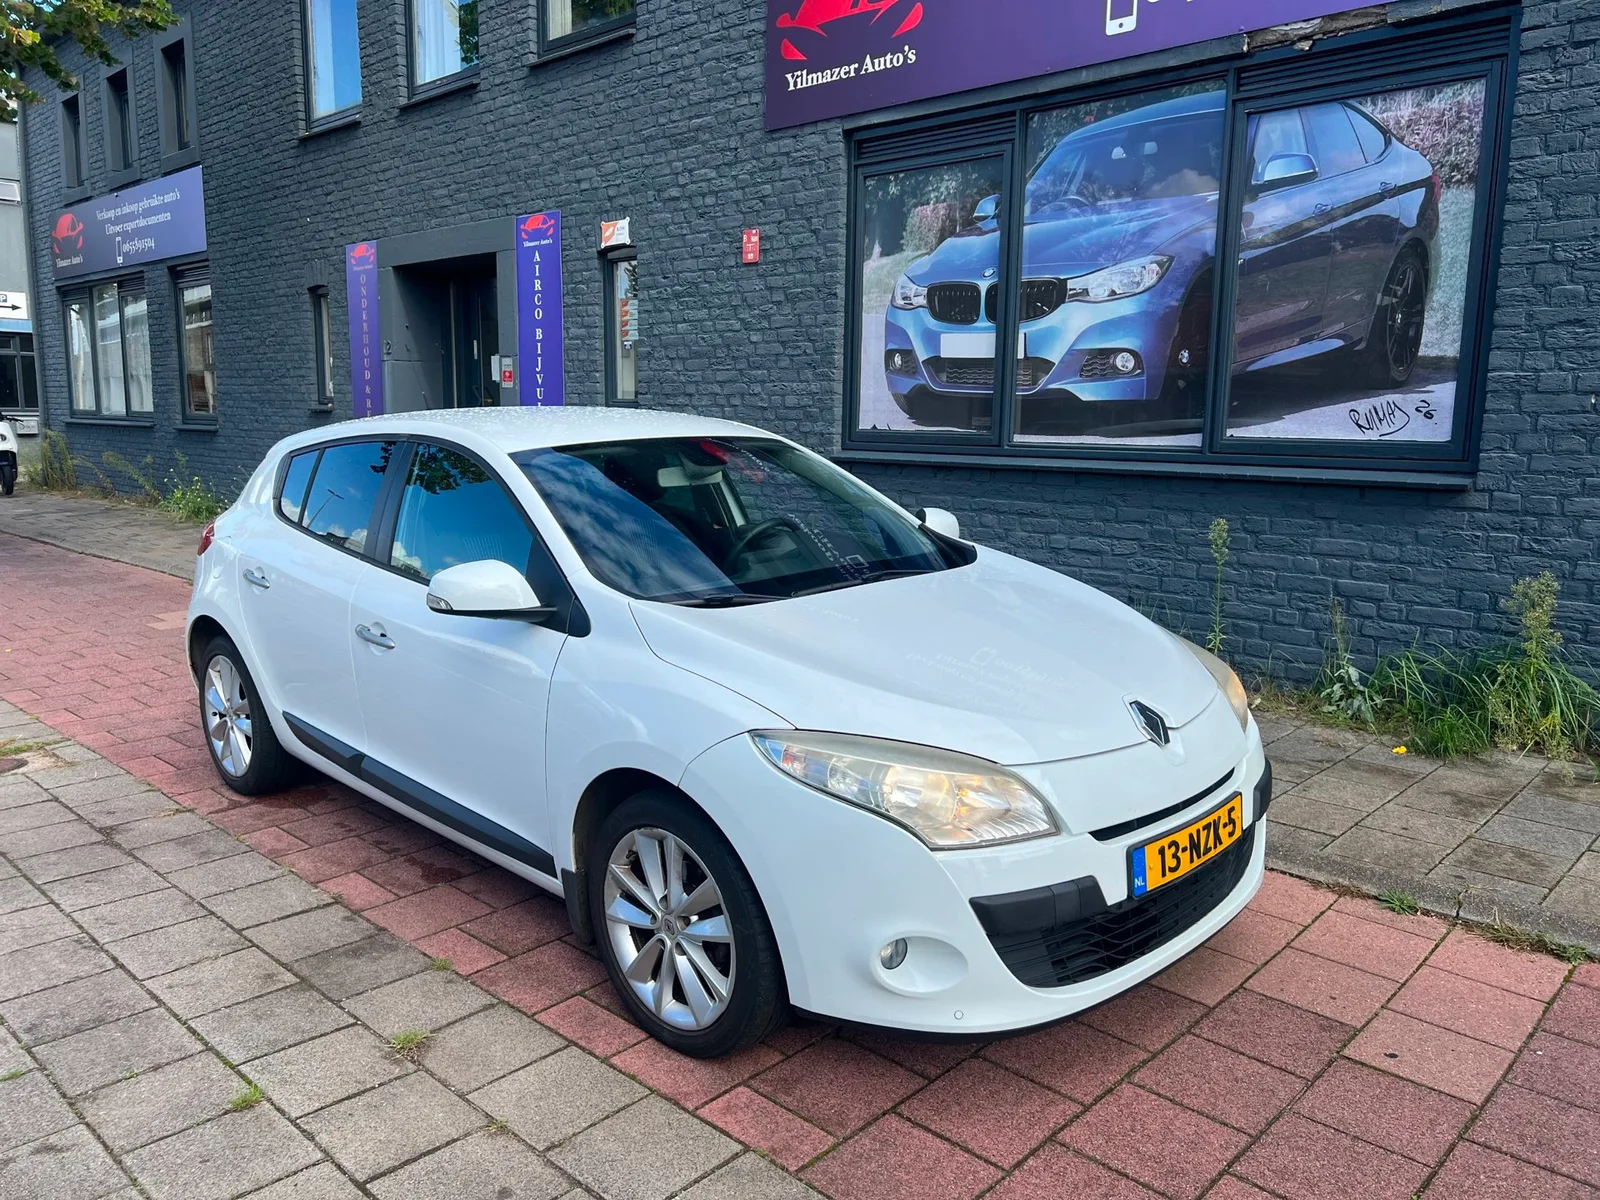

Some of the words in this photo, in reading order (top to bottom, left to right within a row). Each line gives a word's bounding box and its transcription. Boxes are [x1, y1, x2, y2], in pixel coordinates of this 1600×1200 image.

[785, 62, 859, 91] Yilmazer
[860, 45, 917, 75] Auto's
[96, 208, 115, 220] Verkoop
[116, 207, 121, 216] en
[121, 202, 138, 214] inkoop
[139, 195, 163, 214] gebruikte
[164, 188, 180, 203] auto's
[105, 223, 123, 235] Uitvoer
[123, 212, 171, 233] exportdocumenten
[533, 250, 543, 320] AIRCO
[360, 273, 371, 380] ONDERHOUD
[1157, 805, 1237, 879] 13-NZK-5
[1134, 875, 1145, 889] NL
